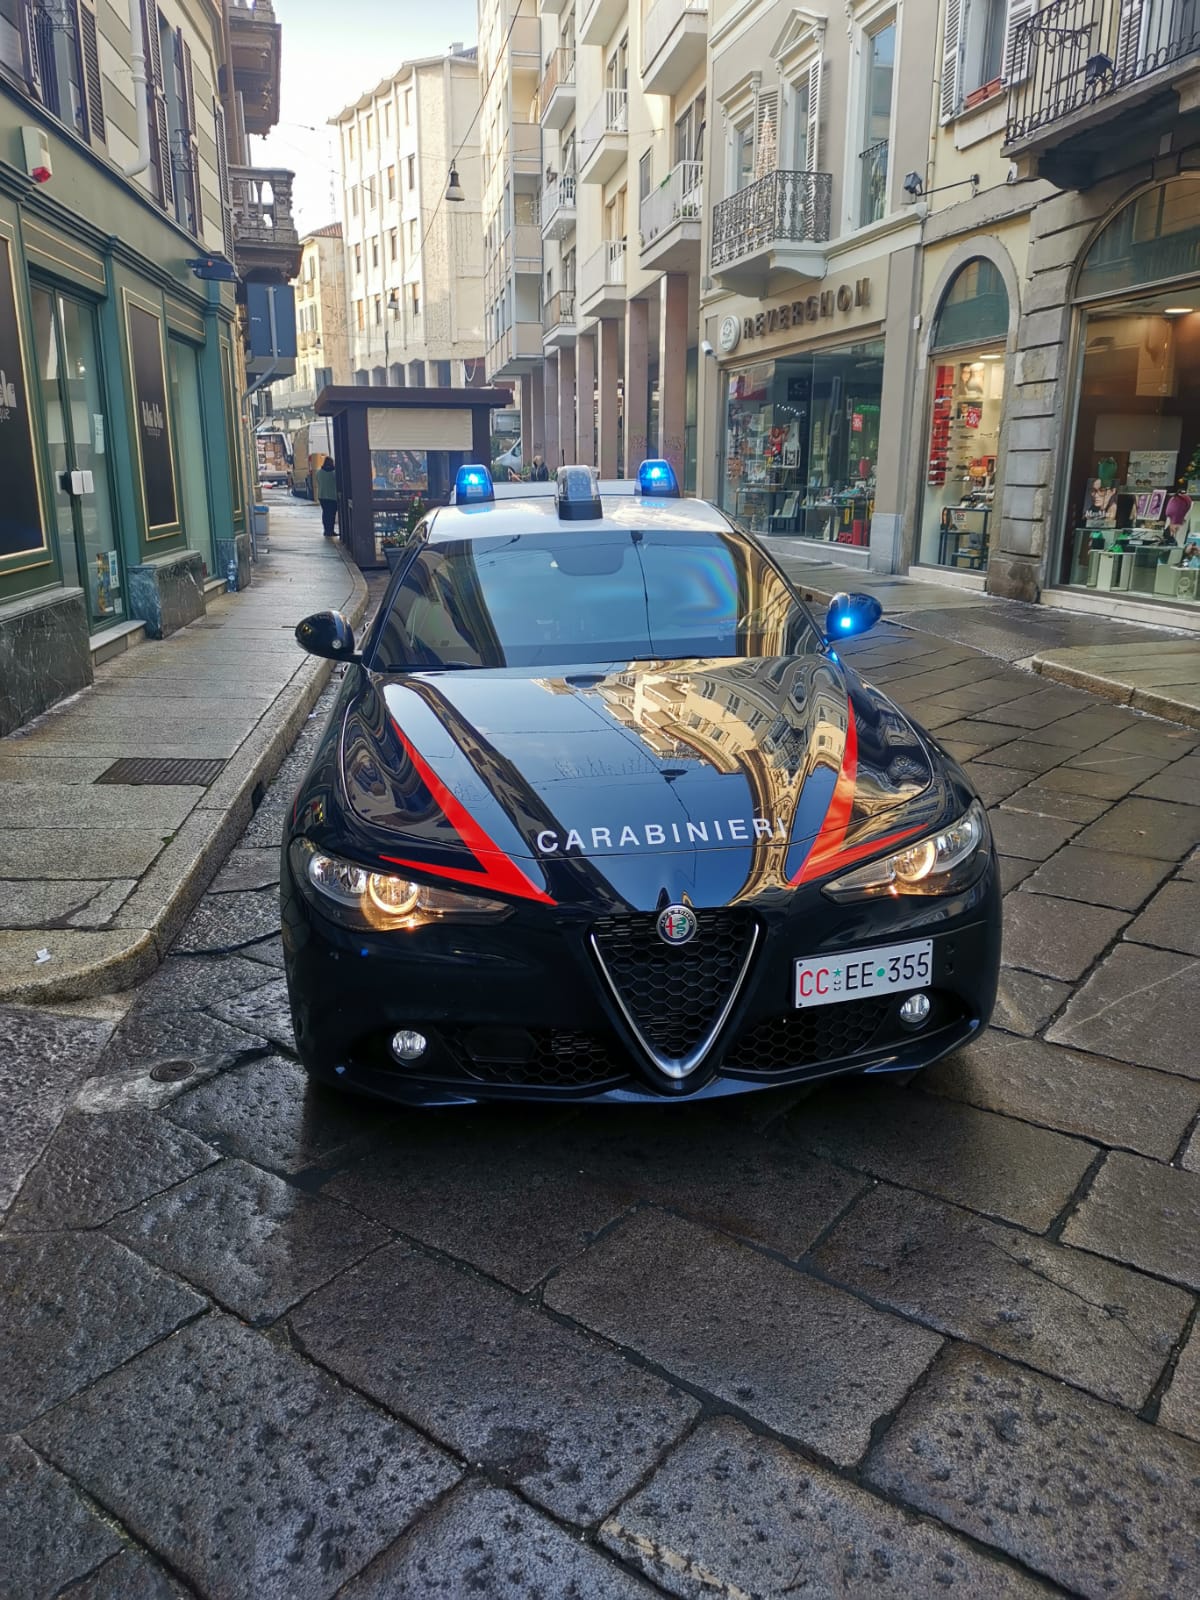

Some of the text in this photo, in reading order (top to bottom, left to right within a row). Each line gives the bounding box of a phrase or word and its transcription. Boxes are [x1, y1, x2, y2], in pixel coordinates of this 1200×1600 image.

[743, 277, 871, 340] REVERCHON
[536, 816, 787, 853] CARABINIERI
[799, 951, 930, 997] CC EE 355
